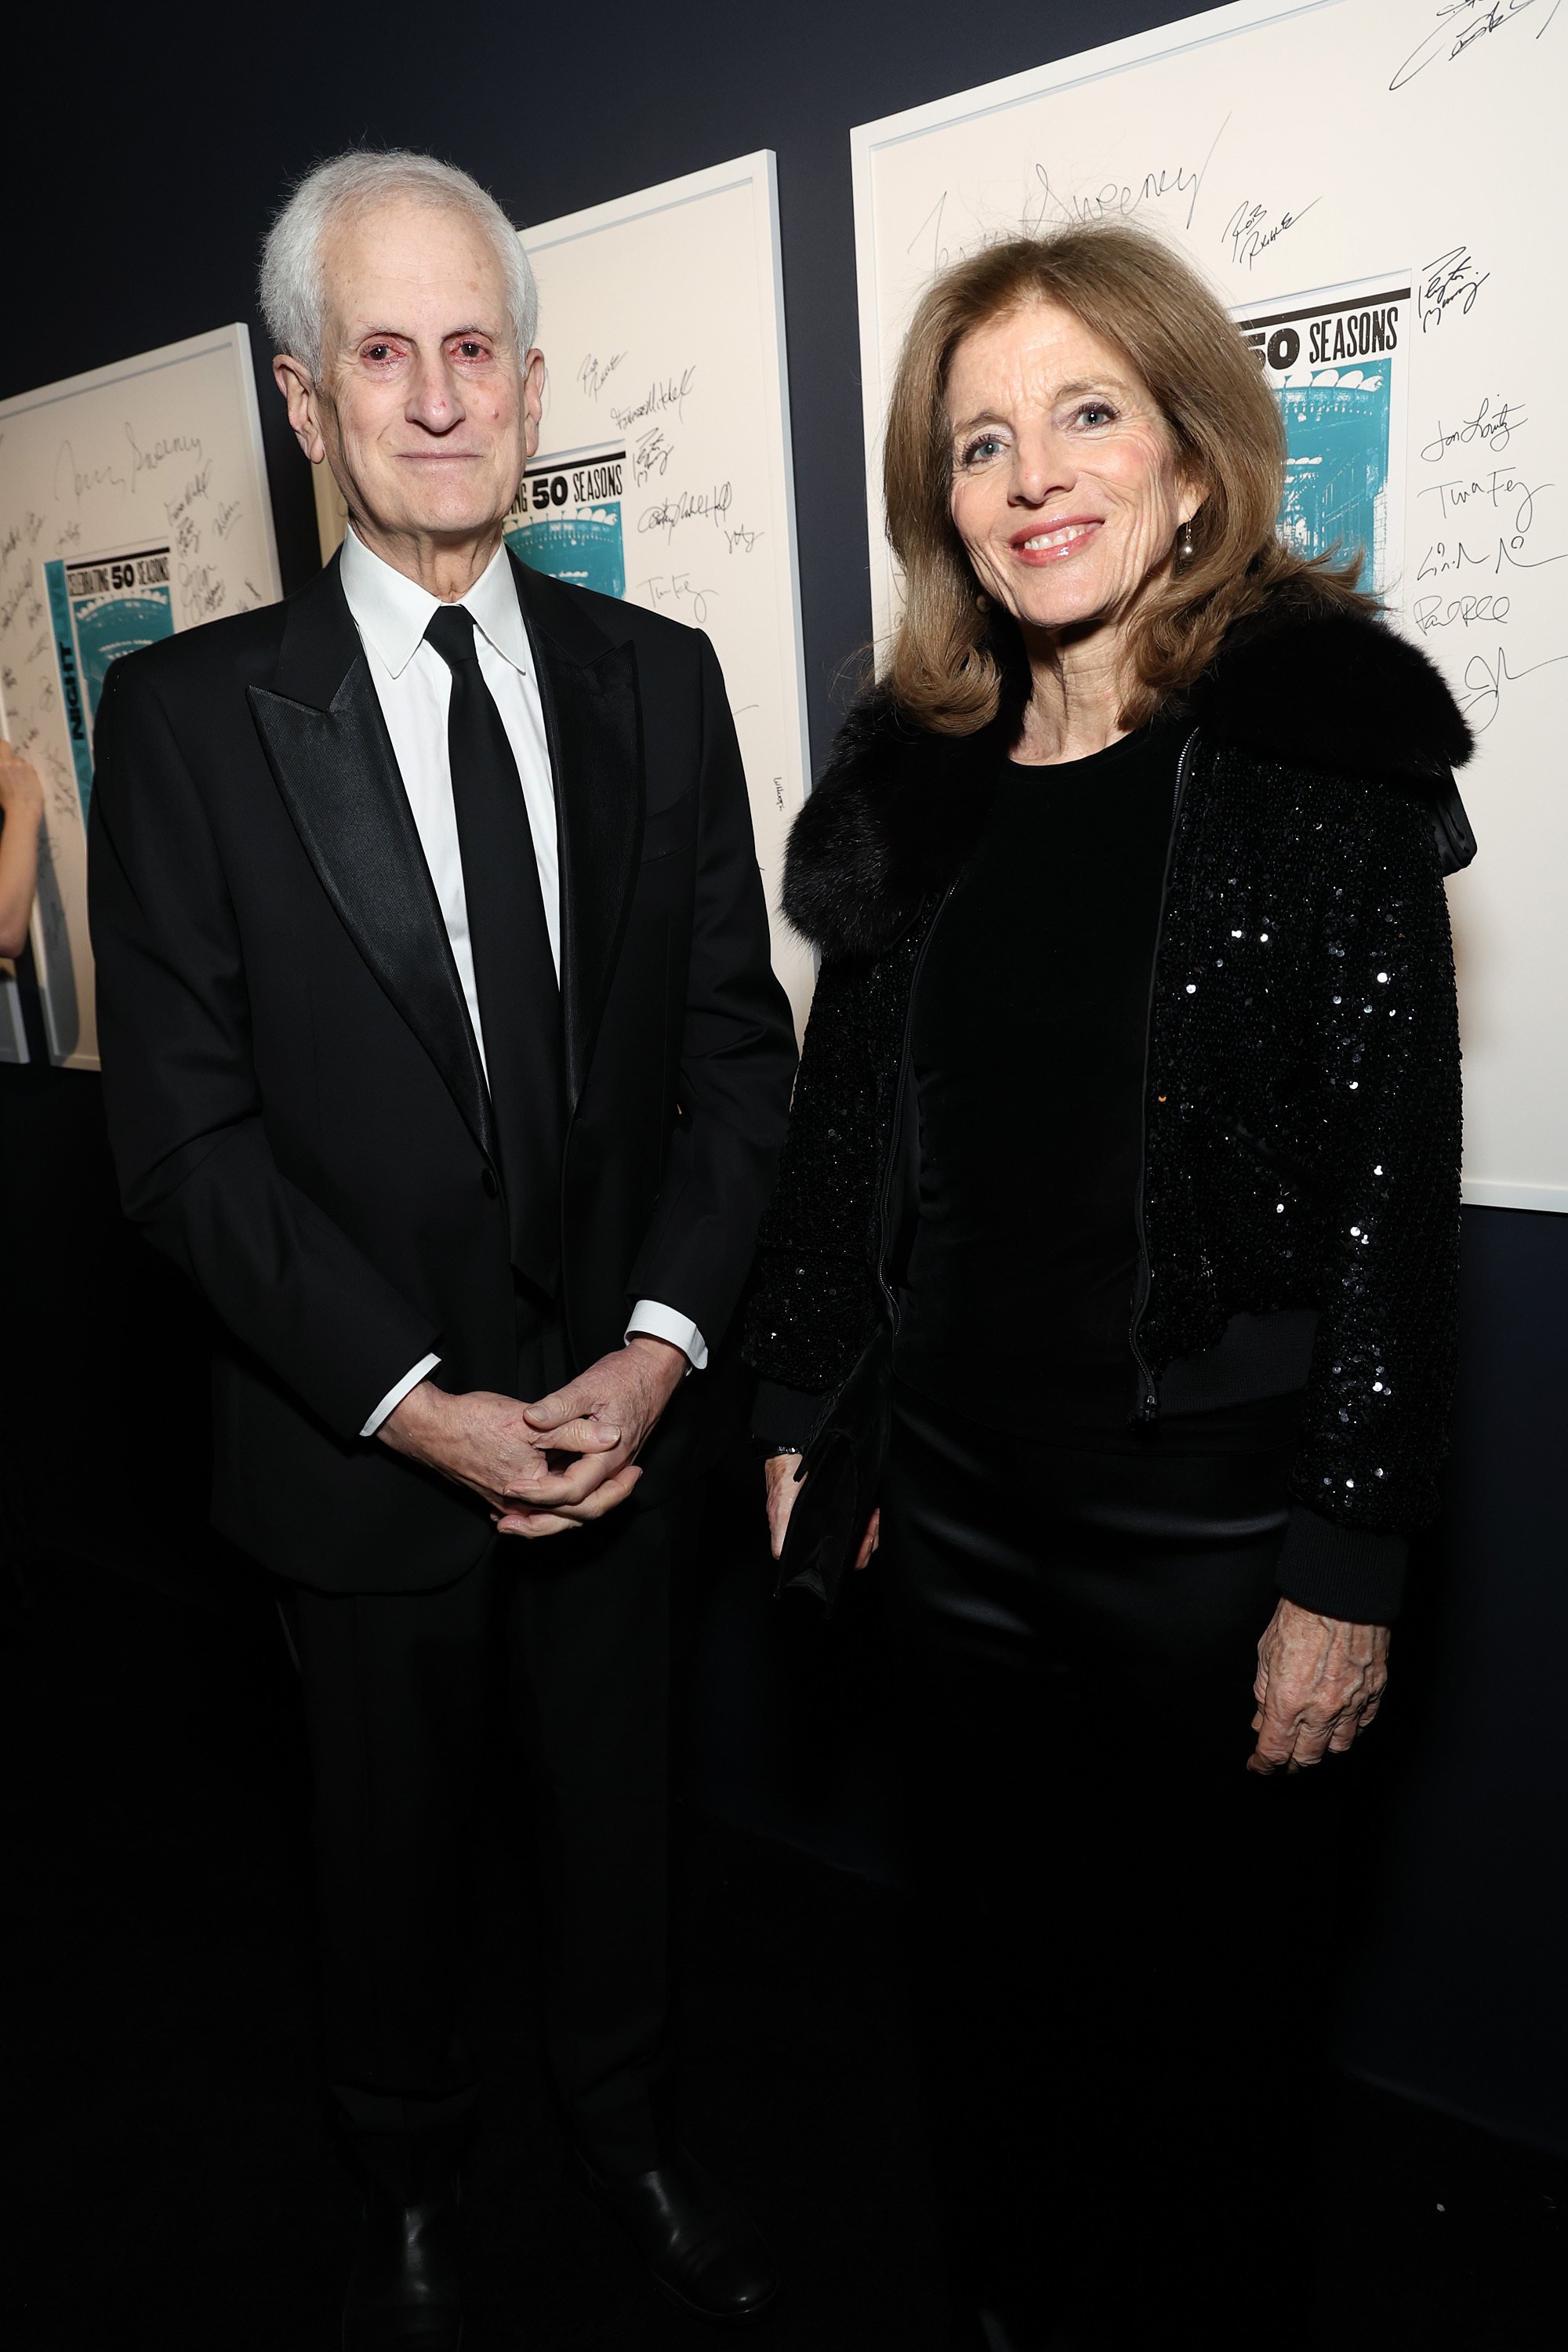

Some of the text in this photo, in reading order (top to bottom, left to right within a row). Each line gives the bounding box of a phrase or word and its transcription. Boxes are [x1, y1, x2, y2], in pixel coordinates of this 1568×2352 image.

[1308, 307, 1399, 364] SEASONS
[532, 476, 568, 510] 50
[572, 464, 622, 503] SEASONS
[1486, 466, 1555, 533] Fey
[111, 564, 135, 590] 50
[59, 641, 84, 741] NIGHT
